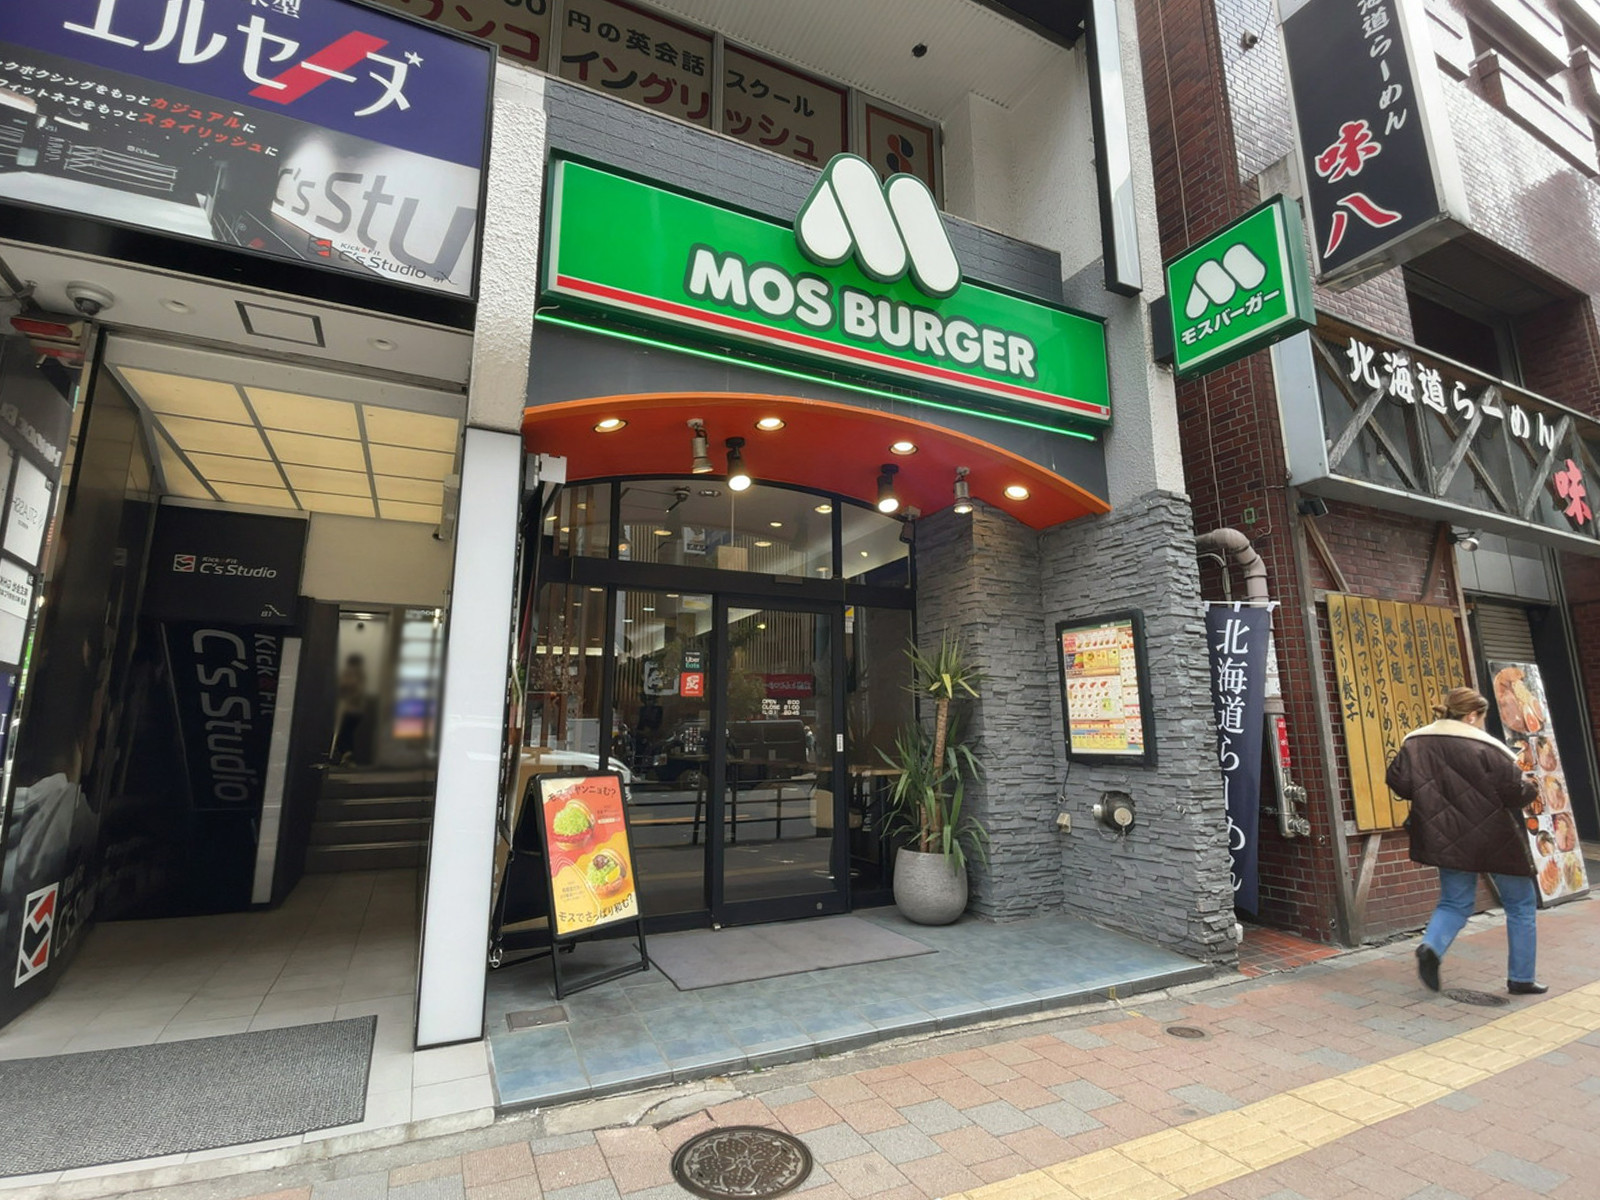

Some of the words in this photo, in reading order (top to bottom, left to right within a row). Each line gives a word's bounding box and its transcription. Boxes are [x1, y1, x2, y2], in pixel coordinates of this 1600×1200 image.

[0, 60, 257, 134] クボクシングをもっとカジュアルに
[1315, 119, 1402, 258] 味八
[368, 256, 427, 279] Studio
[688, 246, 834, 329] MOS
[842, 289, 1037, 380] BURGER
[1181, 289, 1280, 345] モスバーガー
[1346, 337, 1554, 450] 北海道らーめん
[1554, 459, 1592, 525] 味
[225, 565, 277, 579] Studio
[201, 691, 257, 801] Studio
